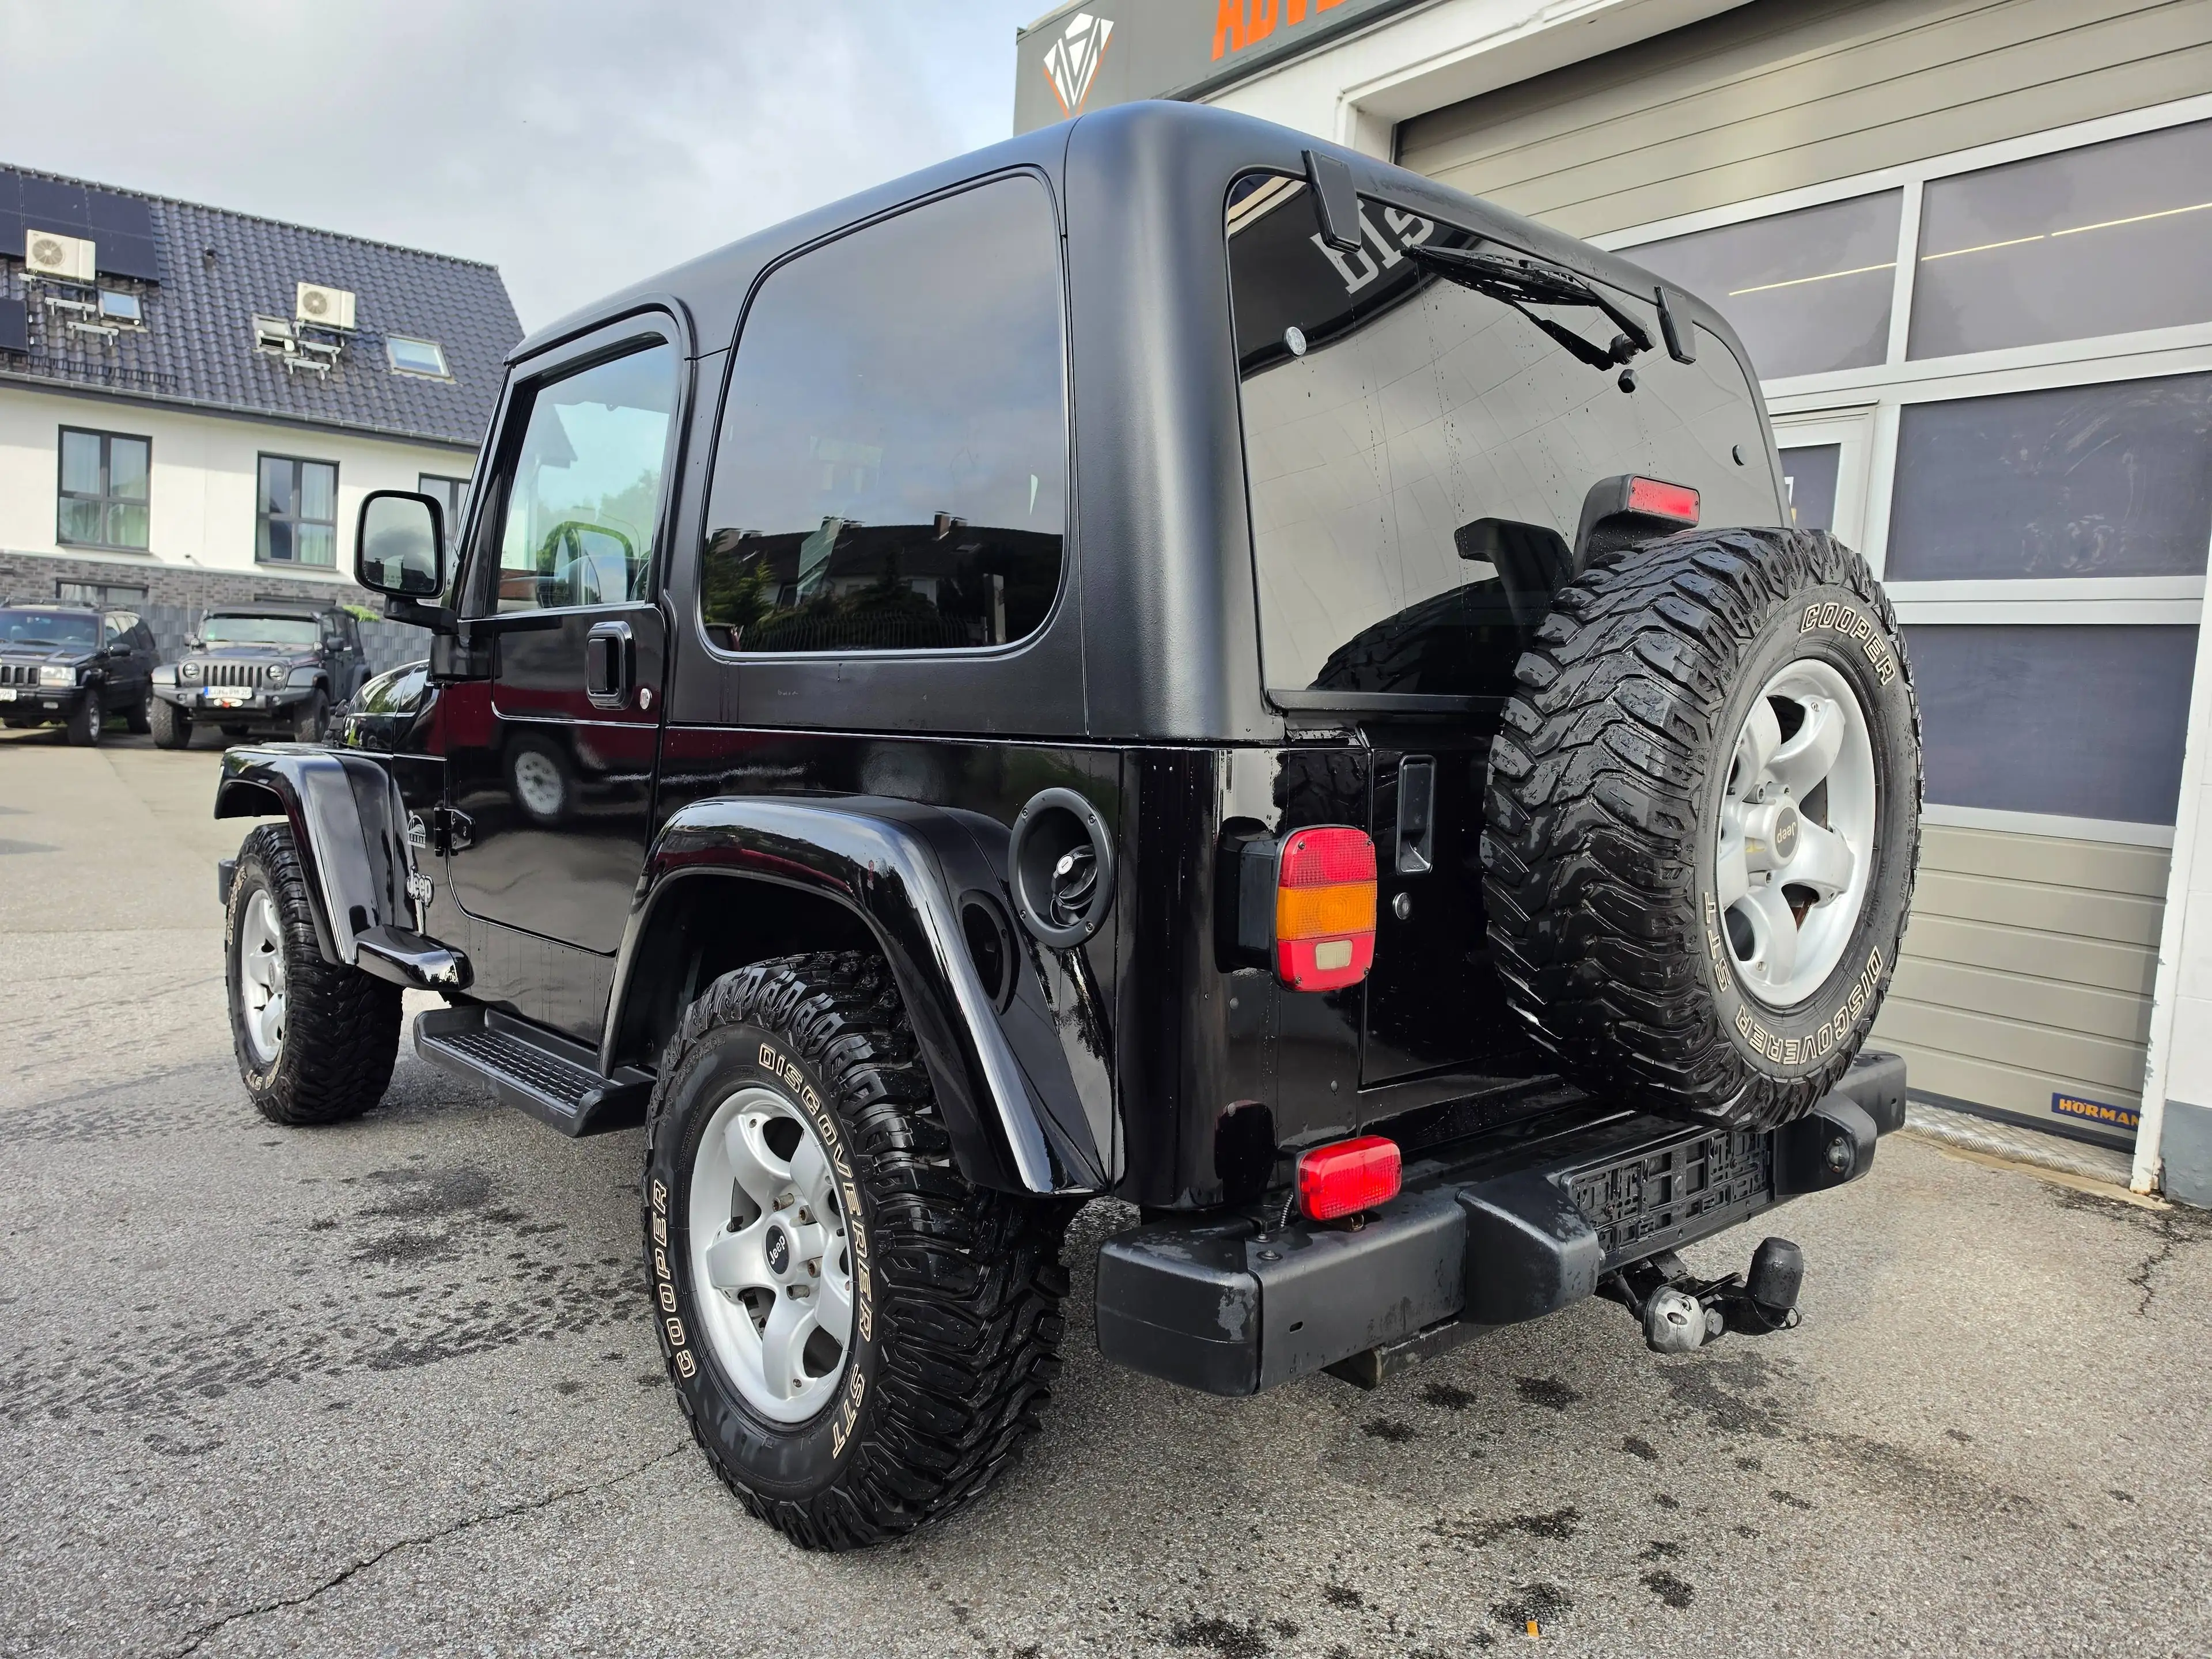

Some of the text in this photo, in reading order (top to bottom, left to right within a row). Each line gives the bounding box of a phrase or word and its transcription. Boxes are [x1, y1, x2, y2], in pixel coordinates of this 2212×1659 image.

[1801, 601, 1896, 685] COOPER
[1777, 821, 1796, 843] Jeep
[407, 866, 433, 906] Jeep
[1703, 892, 1883, 1065] DISCOVERER STT
[652, 1178, 698, 1378] COOPER
[759, 1043, 873, 1459] DISCOVERER STT
[769, 1235, 785, 1265] Jeep
